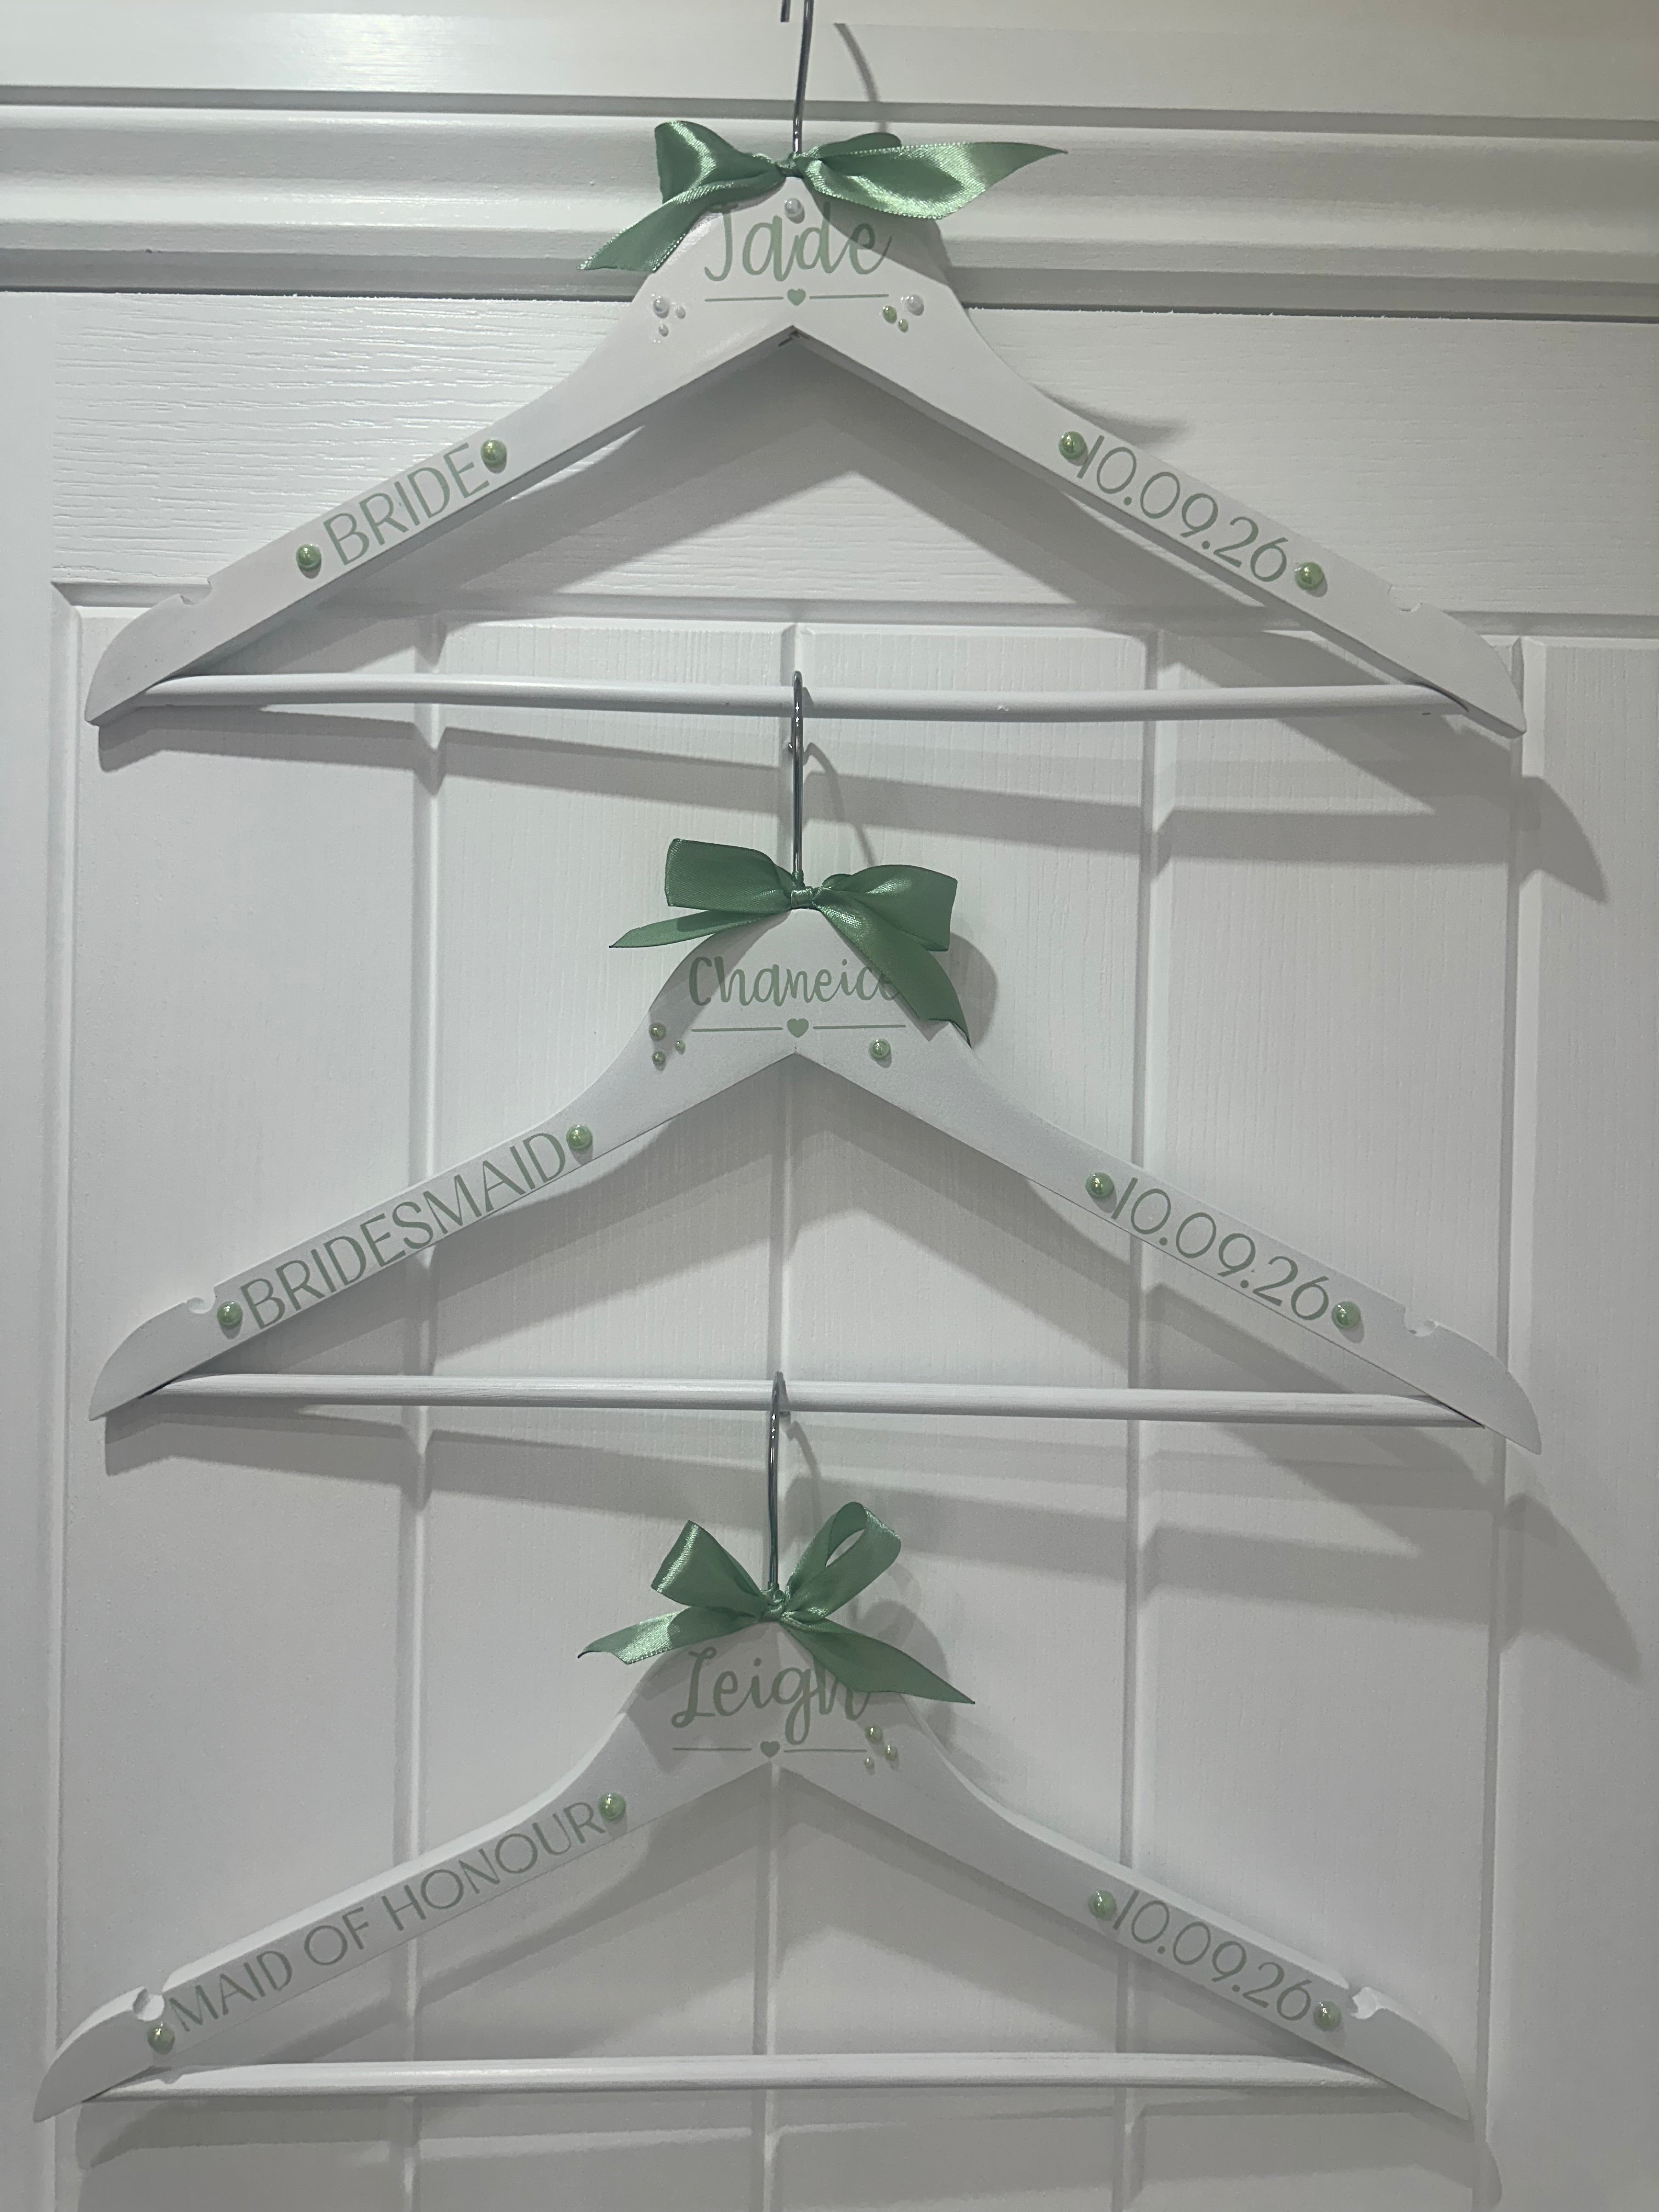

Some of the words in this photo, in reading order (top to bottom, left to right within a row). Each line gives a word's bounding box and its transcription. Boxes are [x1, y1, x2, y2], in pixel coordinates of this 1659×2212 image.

[704, 201, 893, 281] Jade
[323, 442, 490, 566] BRIDE
[1076, 435, 1289, 583] 10.09.26
[240, 1132, 566, 1330] BRIDESMAID
[1110, 1177, 1330, 1321] 10.09.26
[168, 1950, 294, 2032] MAID
[303, 1906, 370, 1967] OF
[381, 1801, 606, 1931] HONOUR
[1112, 1889, 1313, 2022] 10.09.26
